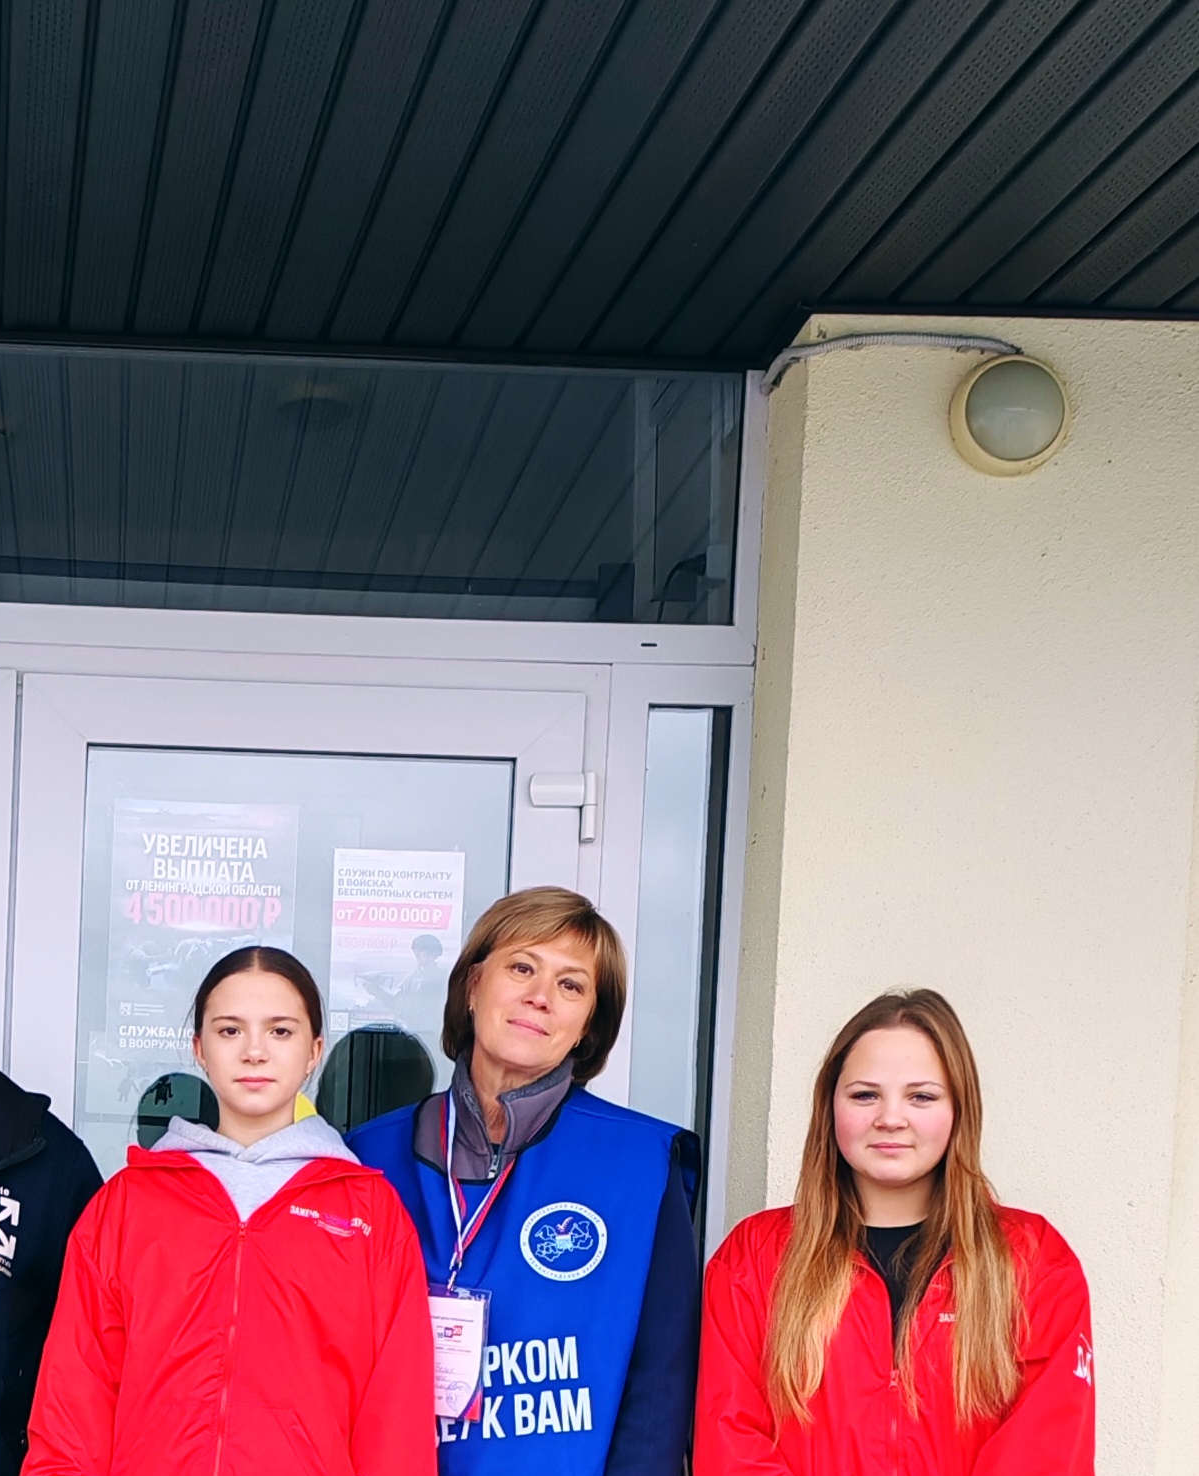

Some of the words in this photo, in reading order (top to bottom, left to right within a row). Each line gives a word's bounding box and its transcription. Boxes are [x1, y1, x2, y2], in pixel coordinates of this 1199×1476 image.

[142, 833, 268, 860] УВЕЛИЧЕНА
[153, 858, 255, 883] ВЫПЛАТА
[338, 868, 375, 879] СЛУЖИ
[378, 870, 391, 878] ПО
[393, 870, 452, 880] КОНТРАКТУ
[126, 879, 140, 891] ОТ
[140, 880, 231, 896] ЛЕНИНГРАДСКОЙ
[232, 884, 281, 897] ОБЛАСТИ
[338, 878, 344, 886] В
[346, 877, 394, 888] ВОЙСКАХ
[338, 887, 412, 899] БЕСПИЛОТНЫХ
[413, 890, 453, 900] СИСТЕМ
[124, 891, 143, 924] 4
[336, 908, 354, 920] от
[355, 905, 367, 921] 7
[368, 906, 398, 922] 000
[400, 907, 430, 923] 000
[119, 1025, 176, 1039] СЛУЖБА
[119, 1038, 127, 1048] В
[128, 1038, 192, 1050] ВООРУЖЕН
[482, 1395, 506, 1439] К
[514, 1387, 593, 1436] ВАМ
